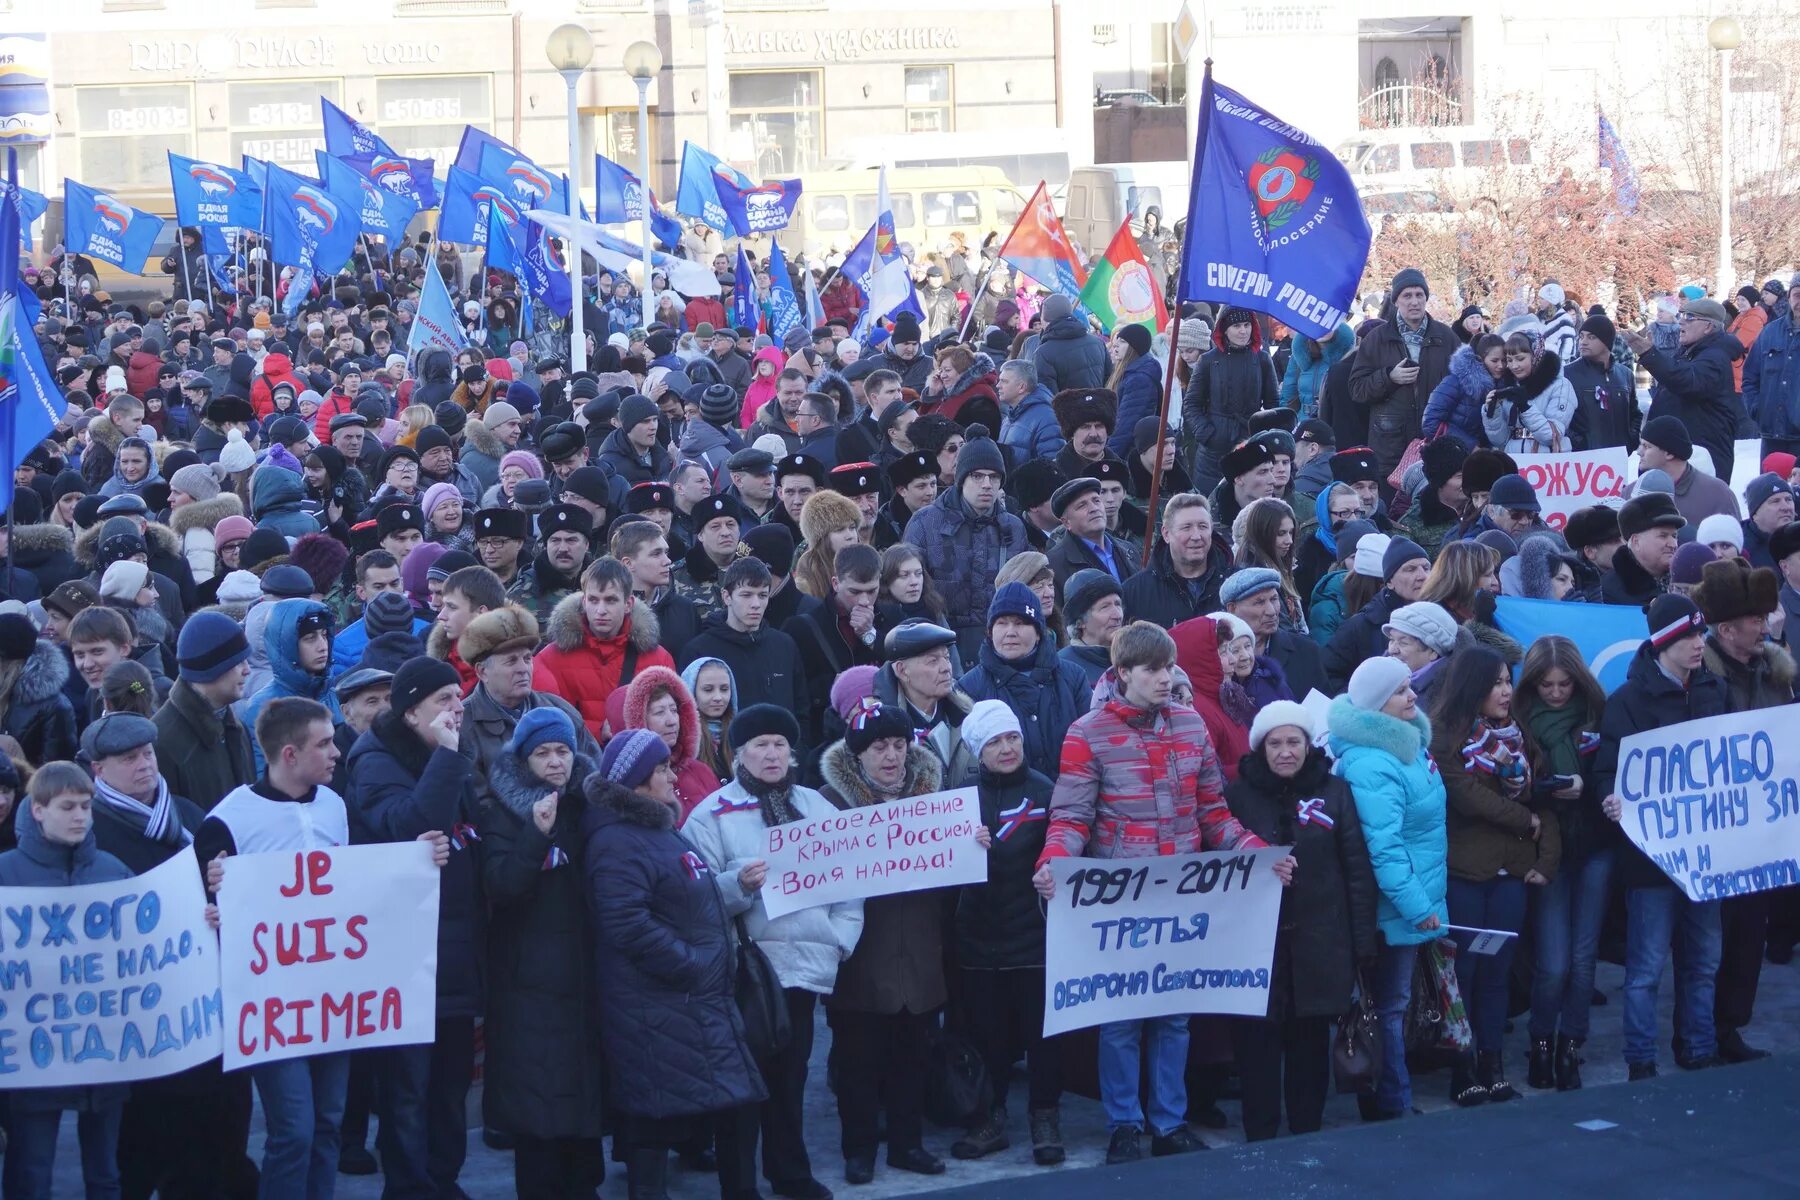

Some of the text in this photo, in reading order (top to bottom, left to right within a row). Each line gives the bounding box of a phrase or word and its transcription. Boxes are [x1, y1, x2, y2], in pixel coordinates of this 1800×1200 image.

[1621, 730, 1774, 802] СПАСИБО
[1637, 777, 1800, 841] ПУТИНУ ЗА
[1066, 866, 1149, 909] 1991
[1176, 853, 1257, 894] 2014
[1697, 844, 1712, 872] И
[0, 890, 161, 949] УЖОГО
[250, 914, 369, 976] SUIS
[60, 953, 105, 985] НЕ
[1053, 970, 1149, 1011] ОБОРОНА
[25, 982, 162, 1024] СВОЕГО
[238, 986, 403, 1056] CRIMEA
